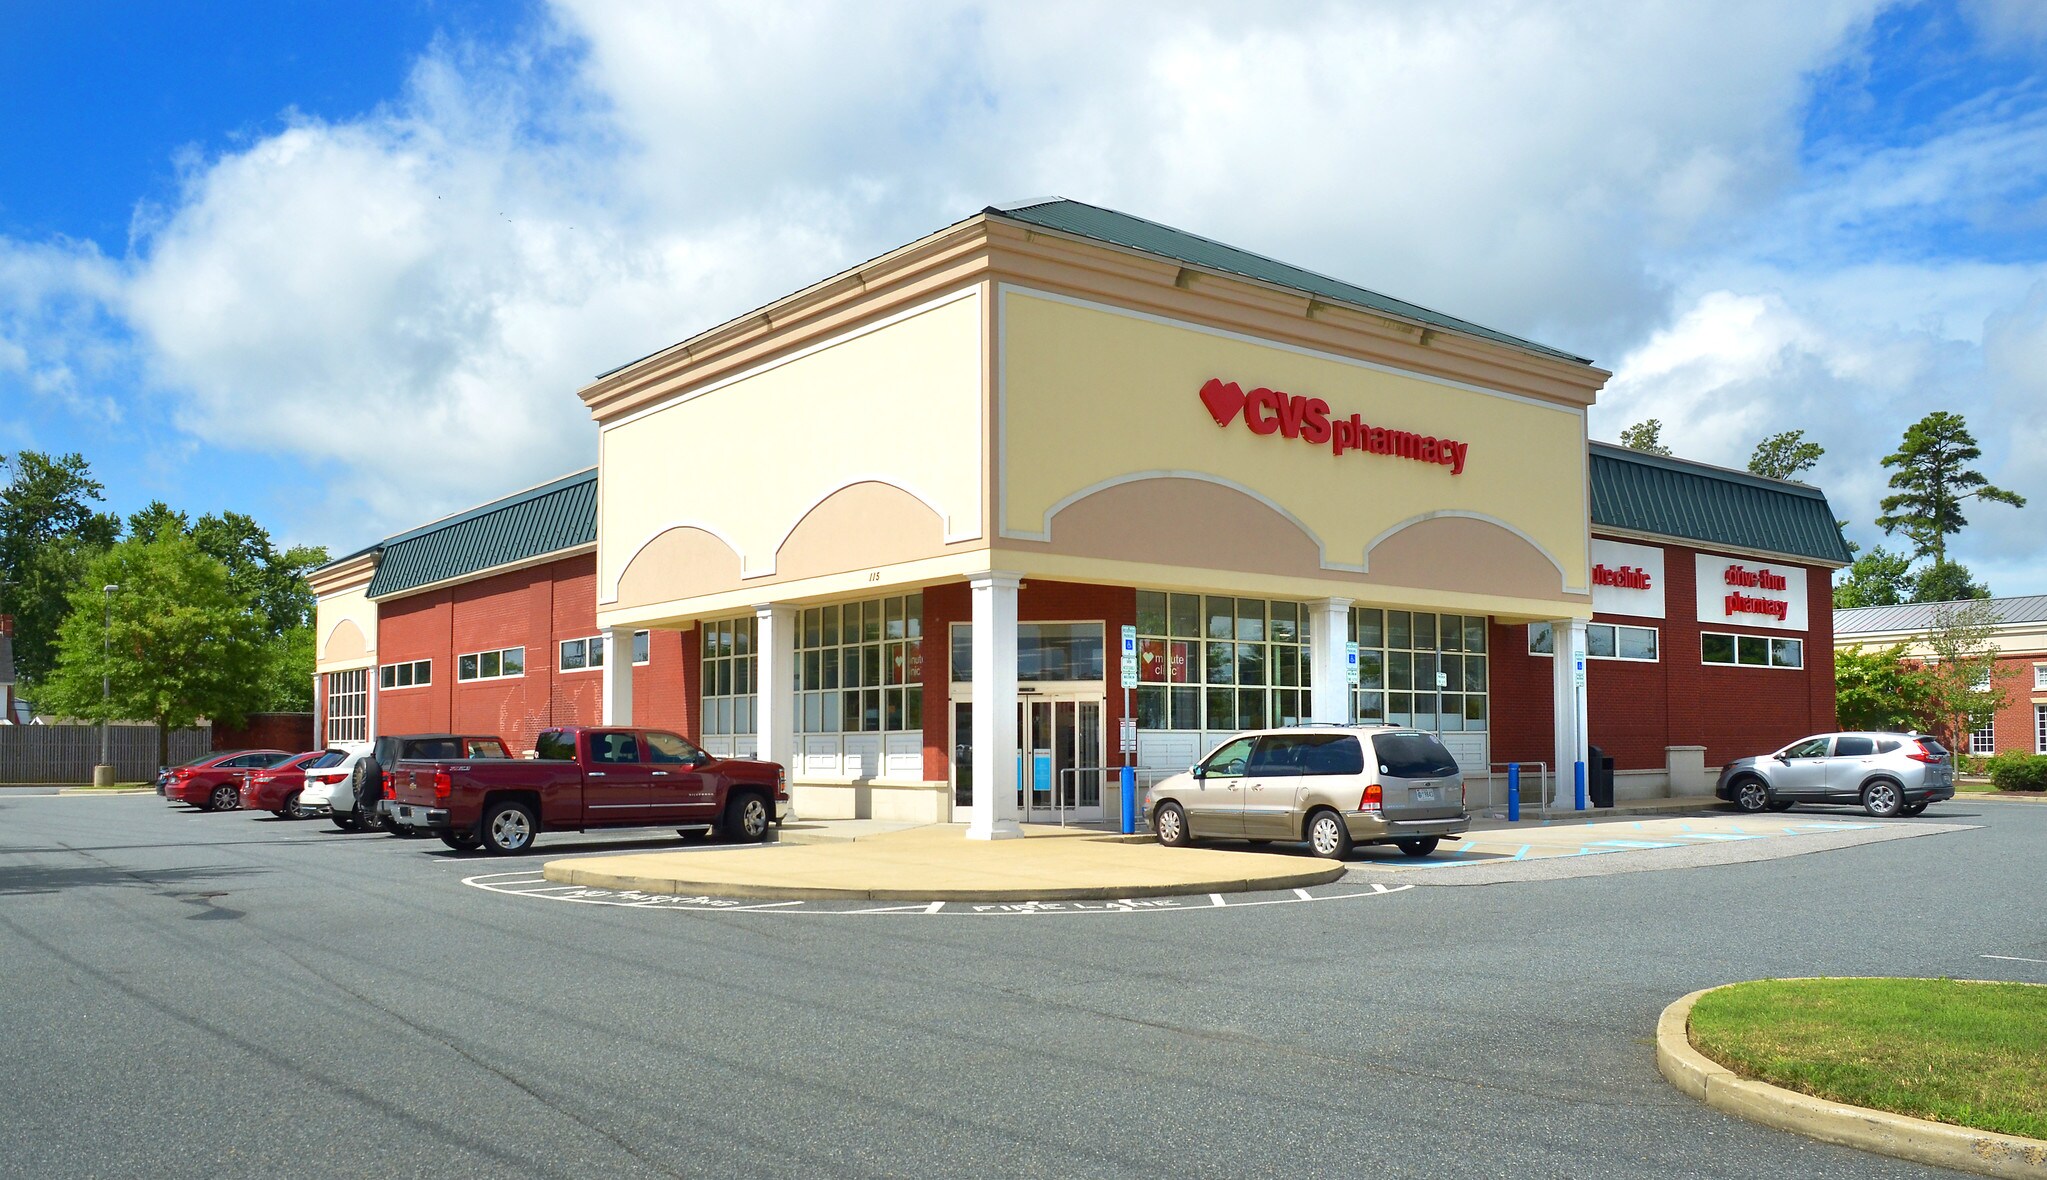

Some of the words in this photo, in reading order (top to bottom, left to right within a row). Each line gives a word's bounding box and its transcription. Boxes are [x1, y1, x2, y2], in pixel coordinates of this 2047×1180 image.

[1244, 388, 1331, 444] CVS
[1332, 414, 1468, 475] pharmacy
[869, 572, 880, 581] 115
[1613, 566, 1652, 590] clinic
[1724, 565, 1786, 591] drive-thru
[1725, 591, 1788, 621] pharmacy
[1155, 654, 1184, 665] mute
[972, 903, 1066, 912] FIRE
[1073, 900, 1181, 909] LANE
